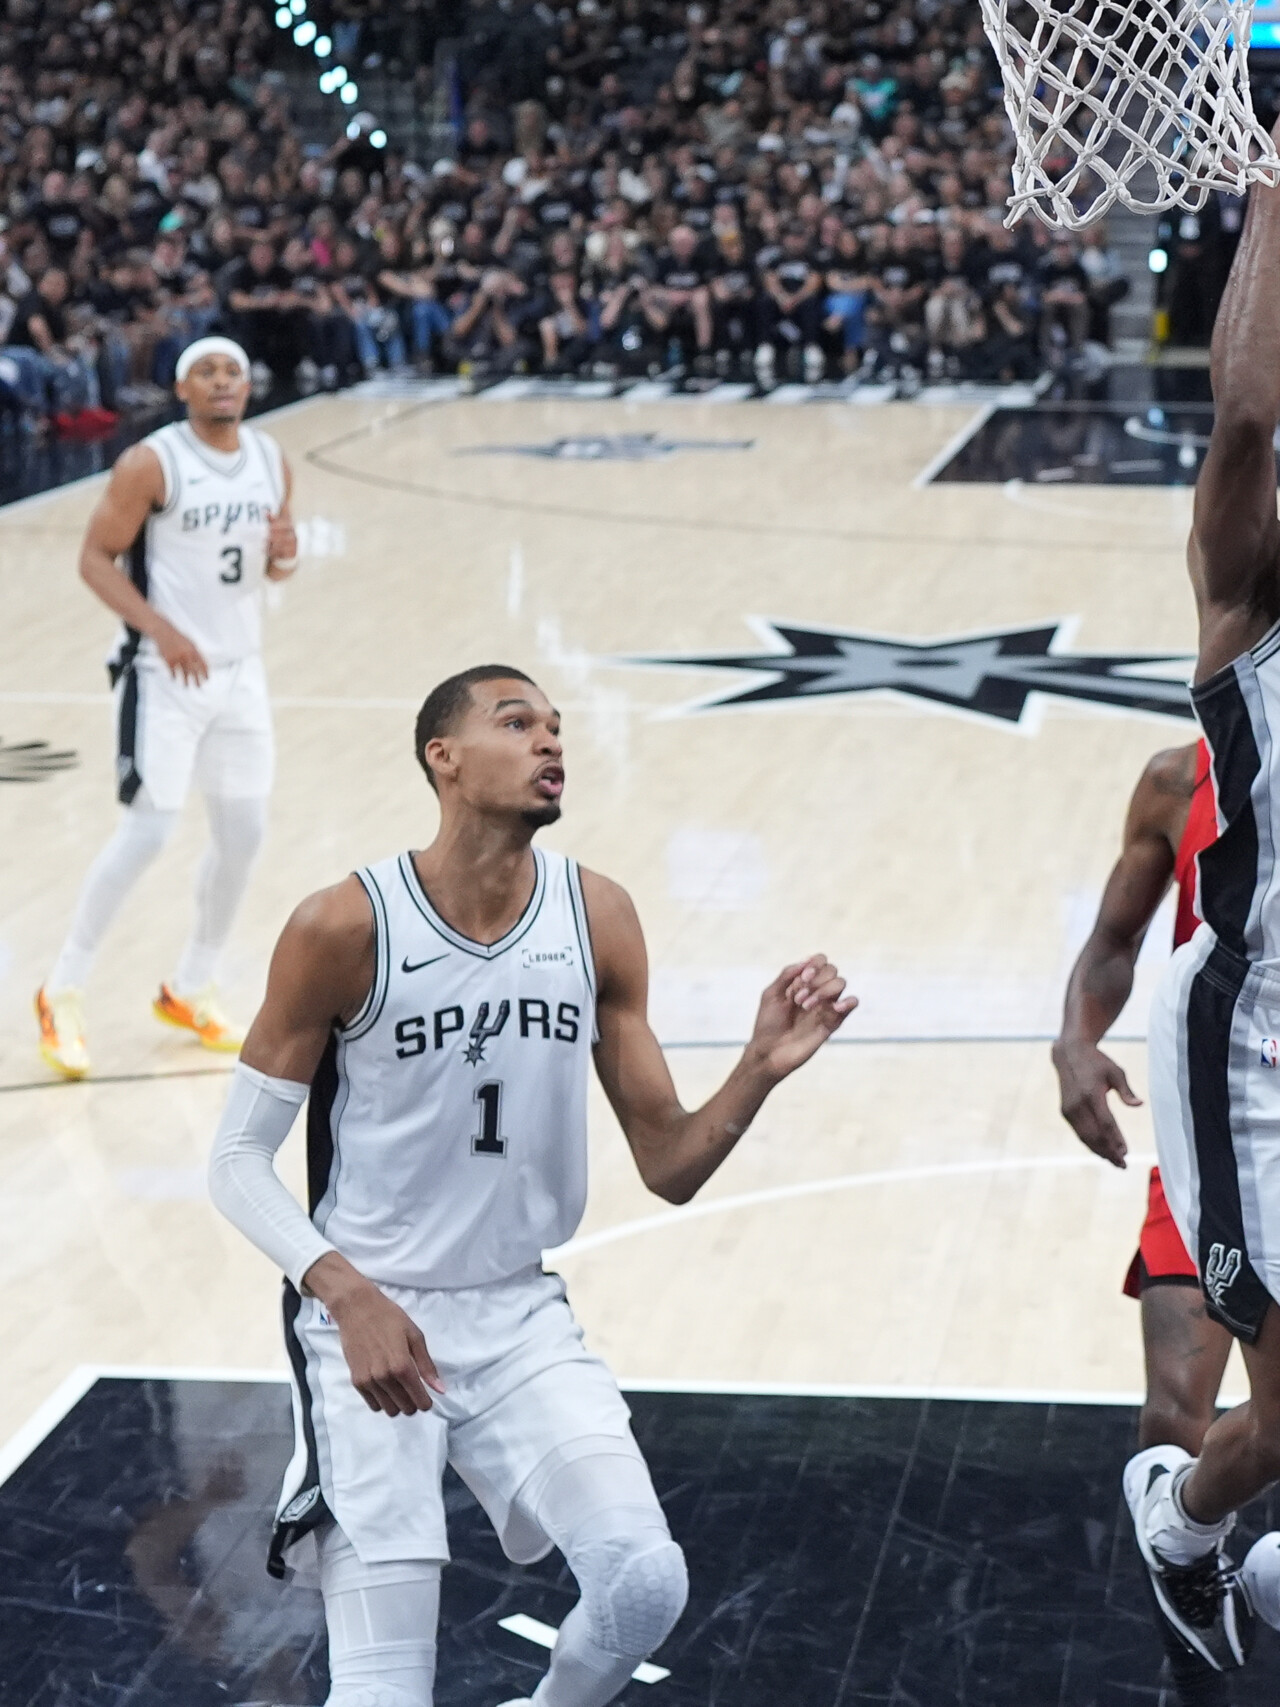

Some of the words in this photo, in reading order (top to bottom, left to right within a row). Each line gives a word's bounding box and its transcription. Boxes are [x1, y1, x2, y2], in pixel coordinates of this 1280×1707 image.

[182, 501, 271, 534] SPUR
[218, 546, 243, 584] 3
[394, 997, 580, 1068] SPURS
[470, 1078, 508, 1159] 1
